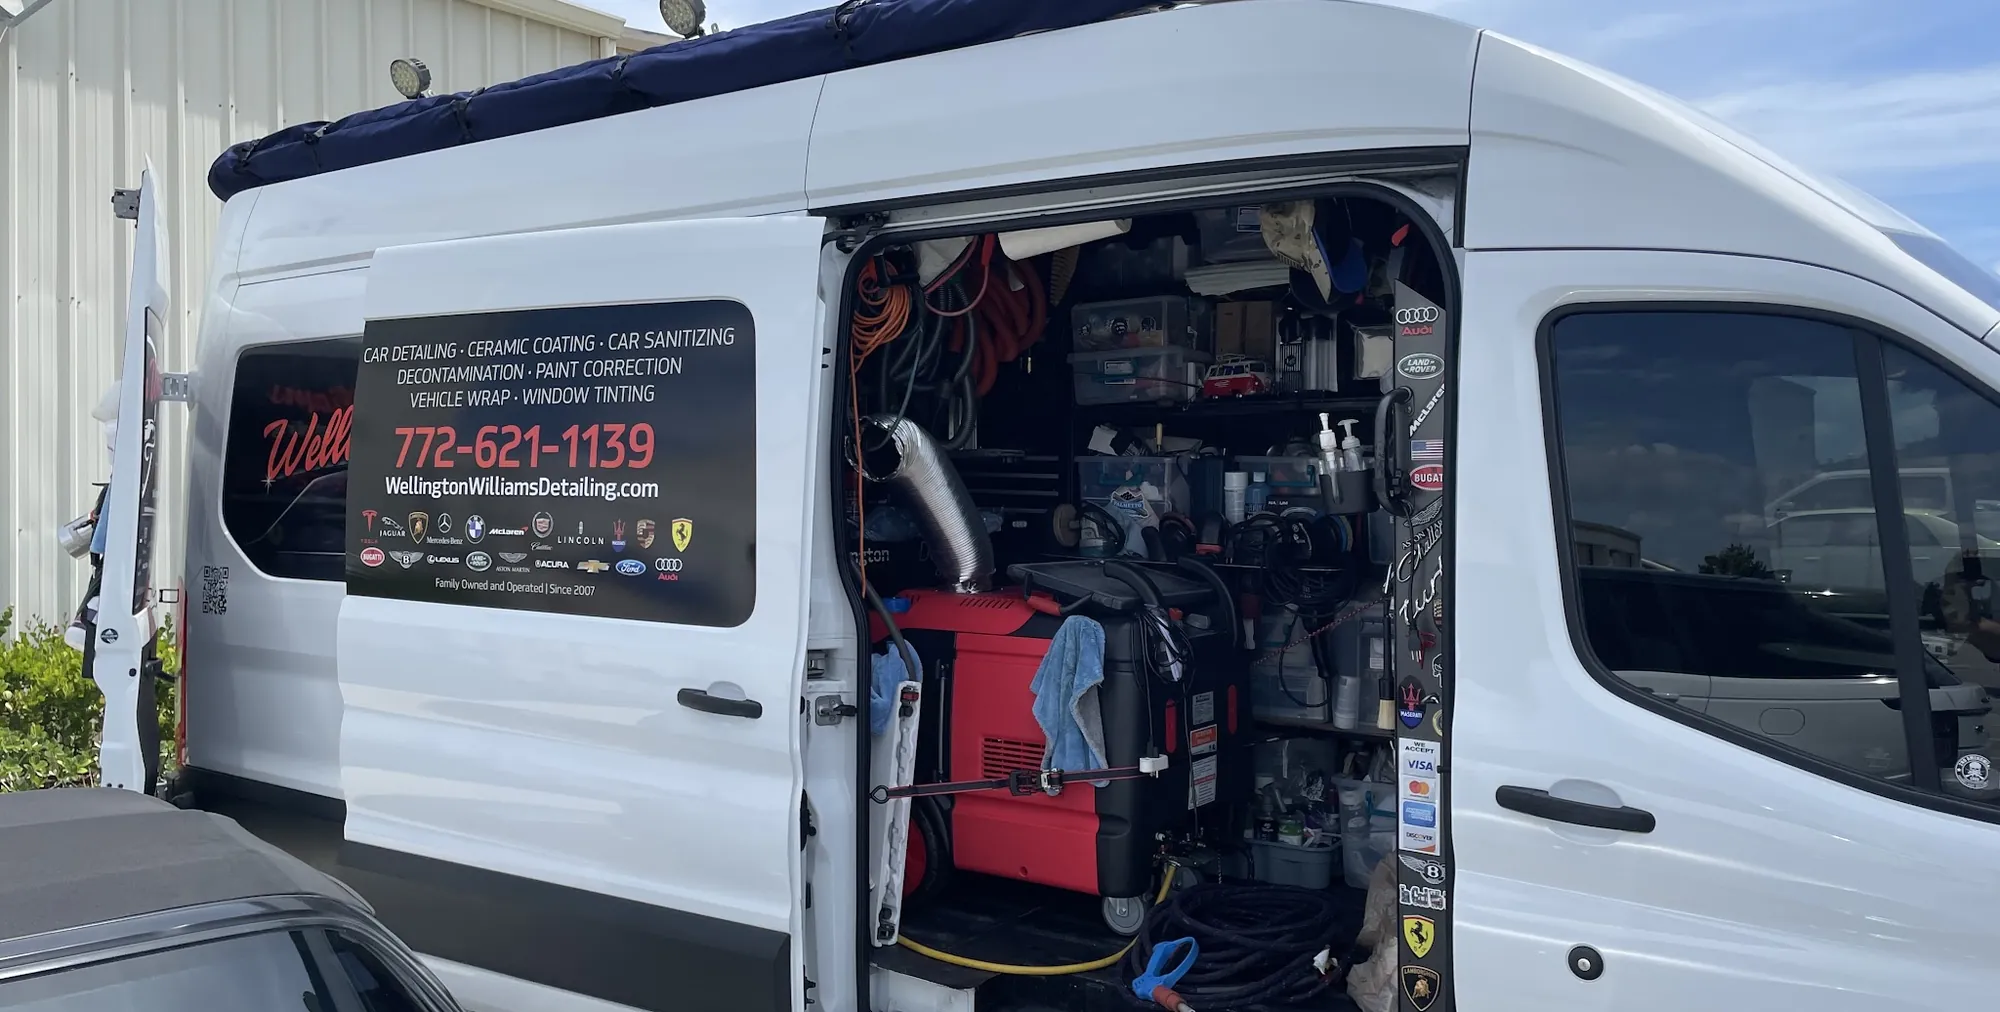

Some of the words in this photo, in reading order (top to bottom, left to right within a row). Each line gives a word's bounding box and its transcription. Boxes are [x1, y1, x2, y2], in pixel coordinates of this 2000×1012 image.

[1402, 325, 1433, 336] Audi
[363, 347, 389, 363] CAR
[391, 342, 457, 362] DETAILING
[467, 337, 530, 358] CERAMIC
[533, 334, 596, 355] COATING
[608, 332, 640, 351] CAR
[644, 327, 736, 349] SANITIZING
[397, 363, 525, 385] DECONTAMINATION
[535, 361, 580, 380] PAINT
[582, 356, 683, 378] CORRECTION
[410, 390, 464, 408] VEHICLE
[467, 389, 511, 407] WRAP
[522, 386, 590, 405] WINDOW
[594, 384, 655, 403] TINTING
[394, 422, 656, 469] 772-621-1139
[384, 475, 660, 501] WellingtonWilliamsDetailing.com
[379, 529, 406, 538] JAGUAR
[488, 528, 525, 536] McLaren
[426, 536, 464, 545] Mercedes-Benz
[557, 536, 605, 545] LINCOLN
[1401, 530, 1426, 550] ASON
[363, 553, 383, 561] BUGATTI
[540, 560, 570, 569] ACURA
[620, 562, 641, 573] Ford
[657, 573, 679, 581] Audi
[435, 577, 460, 591] Family
[461, 578, 489, 591] Owned
[489, 581, 505, 592] and
[506, 581, 544, 594] Operated
[549, 583, 572, 596] Since
[573, 584, 596, 597] 2007
[1404, 745, 1435, 754] ACCEPT
[1408, 759, 1434, 772] VISA
[1405, 831, 1433, 841] DISCOVER
